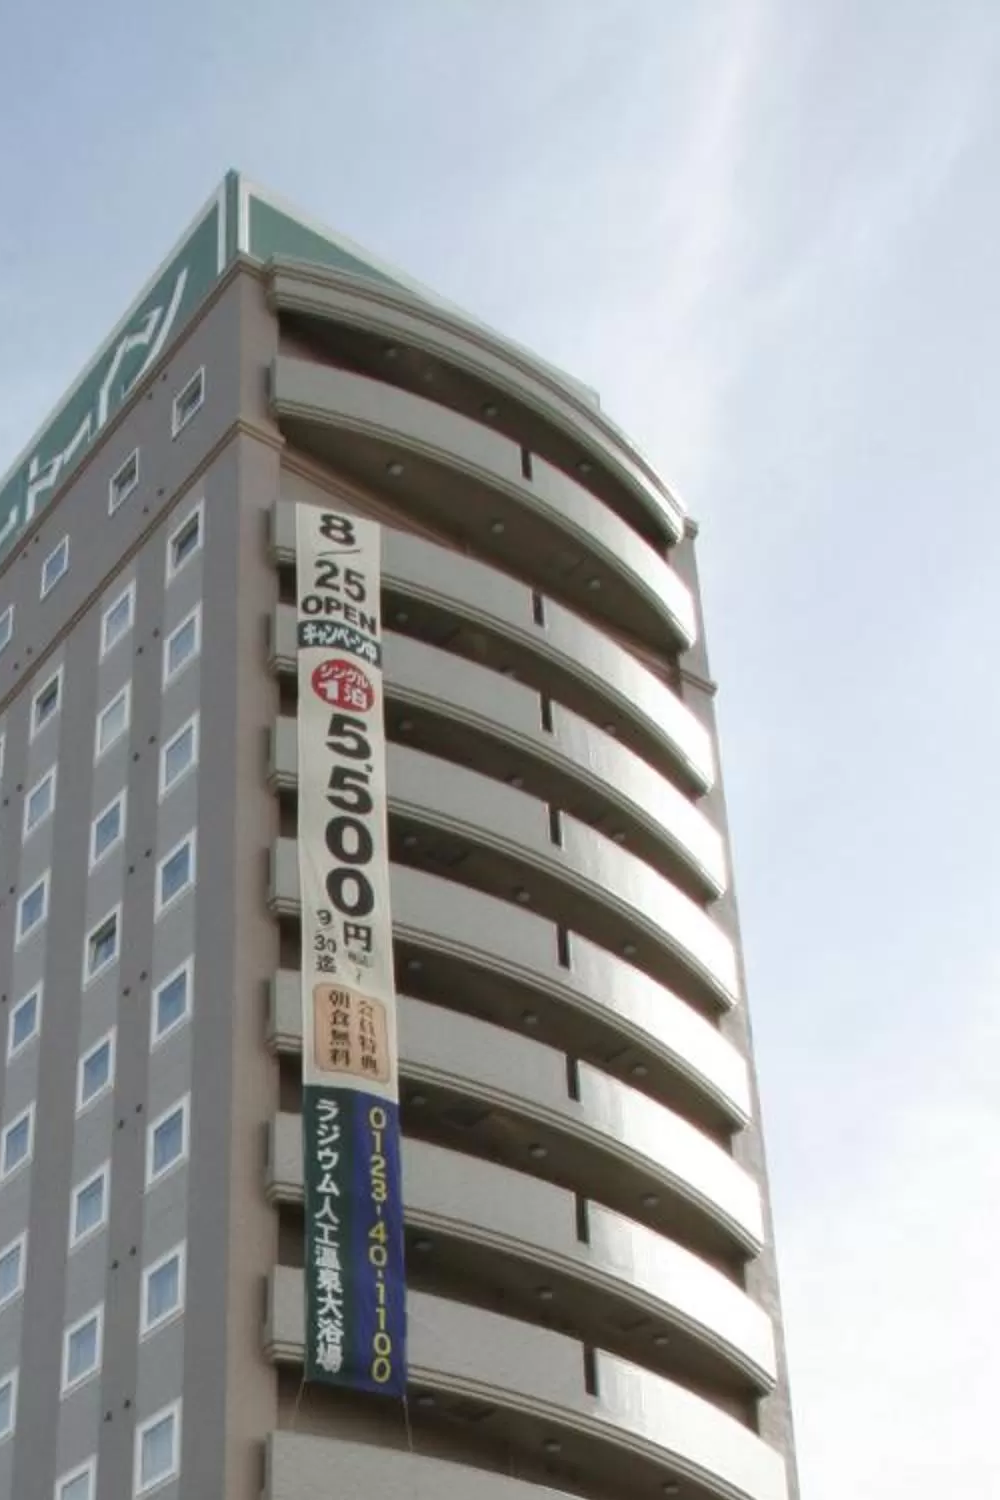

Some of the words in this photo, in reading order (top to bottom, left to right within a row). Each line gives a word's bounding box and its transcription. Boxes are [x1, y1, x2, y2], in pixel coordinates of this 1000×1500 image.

[301, 594, 378, 637] OPEN
[314, 1098, 345, 1374] ラジウム人工温泉大浴場
